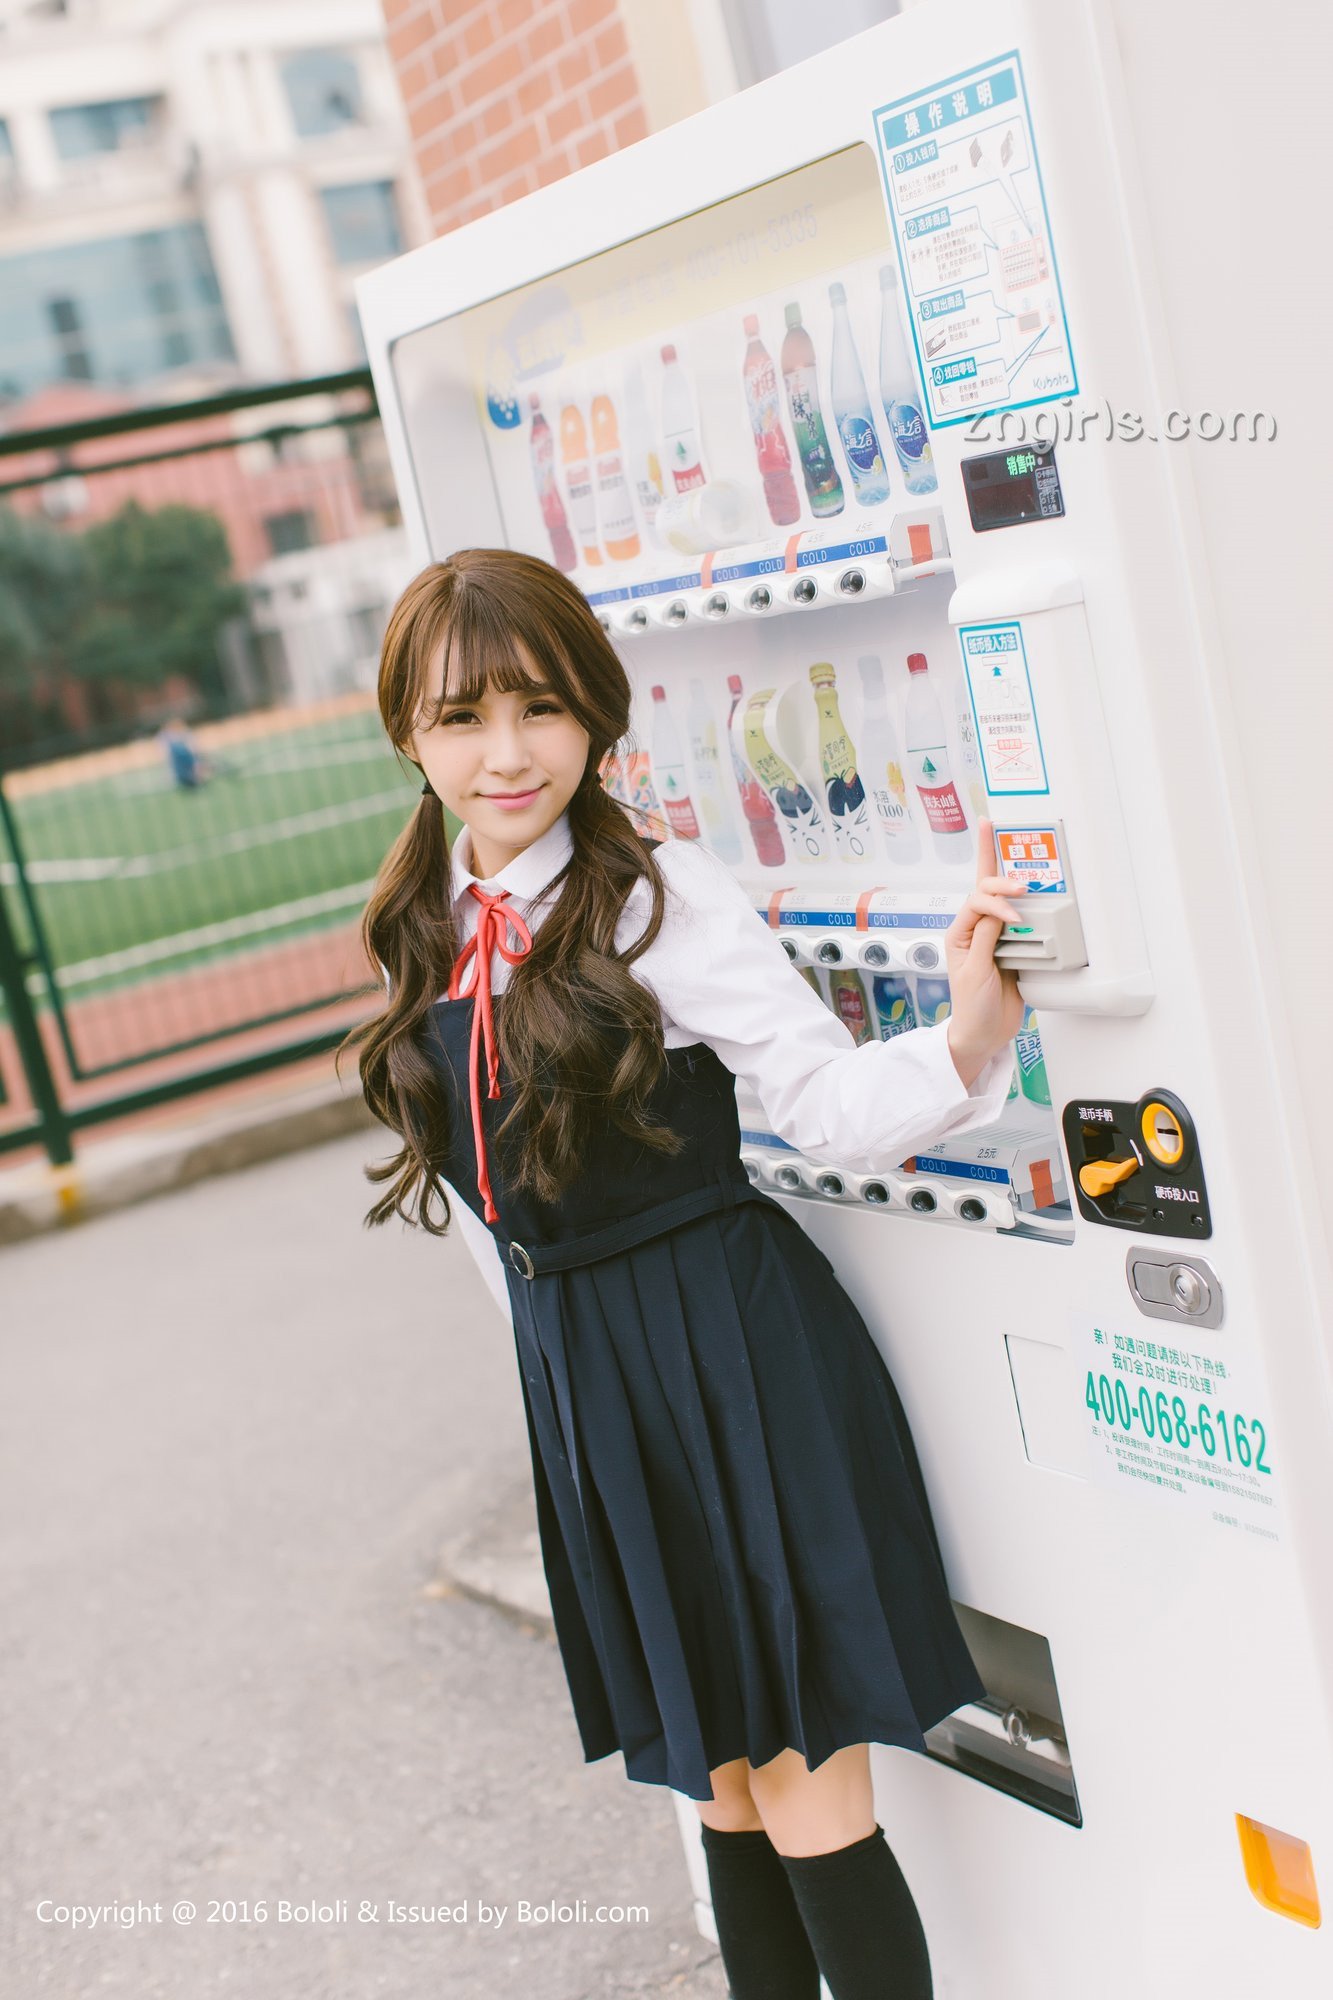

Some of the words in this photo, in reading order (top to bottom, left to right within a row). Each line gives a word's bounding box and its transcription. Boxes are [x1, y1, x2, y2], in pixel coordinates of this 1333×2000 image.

[904, 81, 993, 138] 操作说明
[684, 204, 819, 283] 400-101-5335
[1007, 452, 1037, 477] 销售中
[676, 574, 698, 588] COLD
[716, 566, 739, 582] COLD
[758, 559, 783, 574] COLD
[802, 550, 827, 565] COLD
[849, 541, 875, 556] COLD
[967, 632, 1018, 655] 纸币投入方法
[924, 793, 957, 809] 农夫山泉
[1007, 869, 1060, 881] 纸币投入口
[785, 913, 808, 924] COLD
[828, 914, 853, 926] COLD
[873, 915, 899, 927] COLD
[921, 915, 948, 928] COLD
[1078, 1106, 1114, 1122] 退币手柄
[977, 1147, 997, 1159] 2.5元
[921, 1159, 947, 1173] COLD
[970, 1166, 997, 1181] COLD
[1154, 1185, 1200, 1204] 硬币投入口
[1085, 1371, 1272, 1475] 400-068-6162
